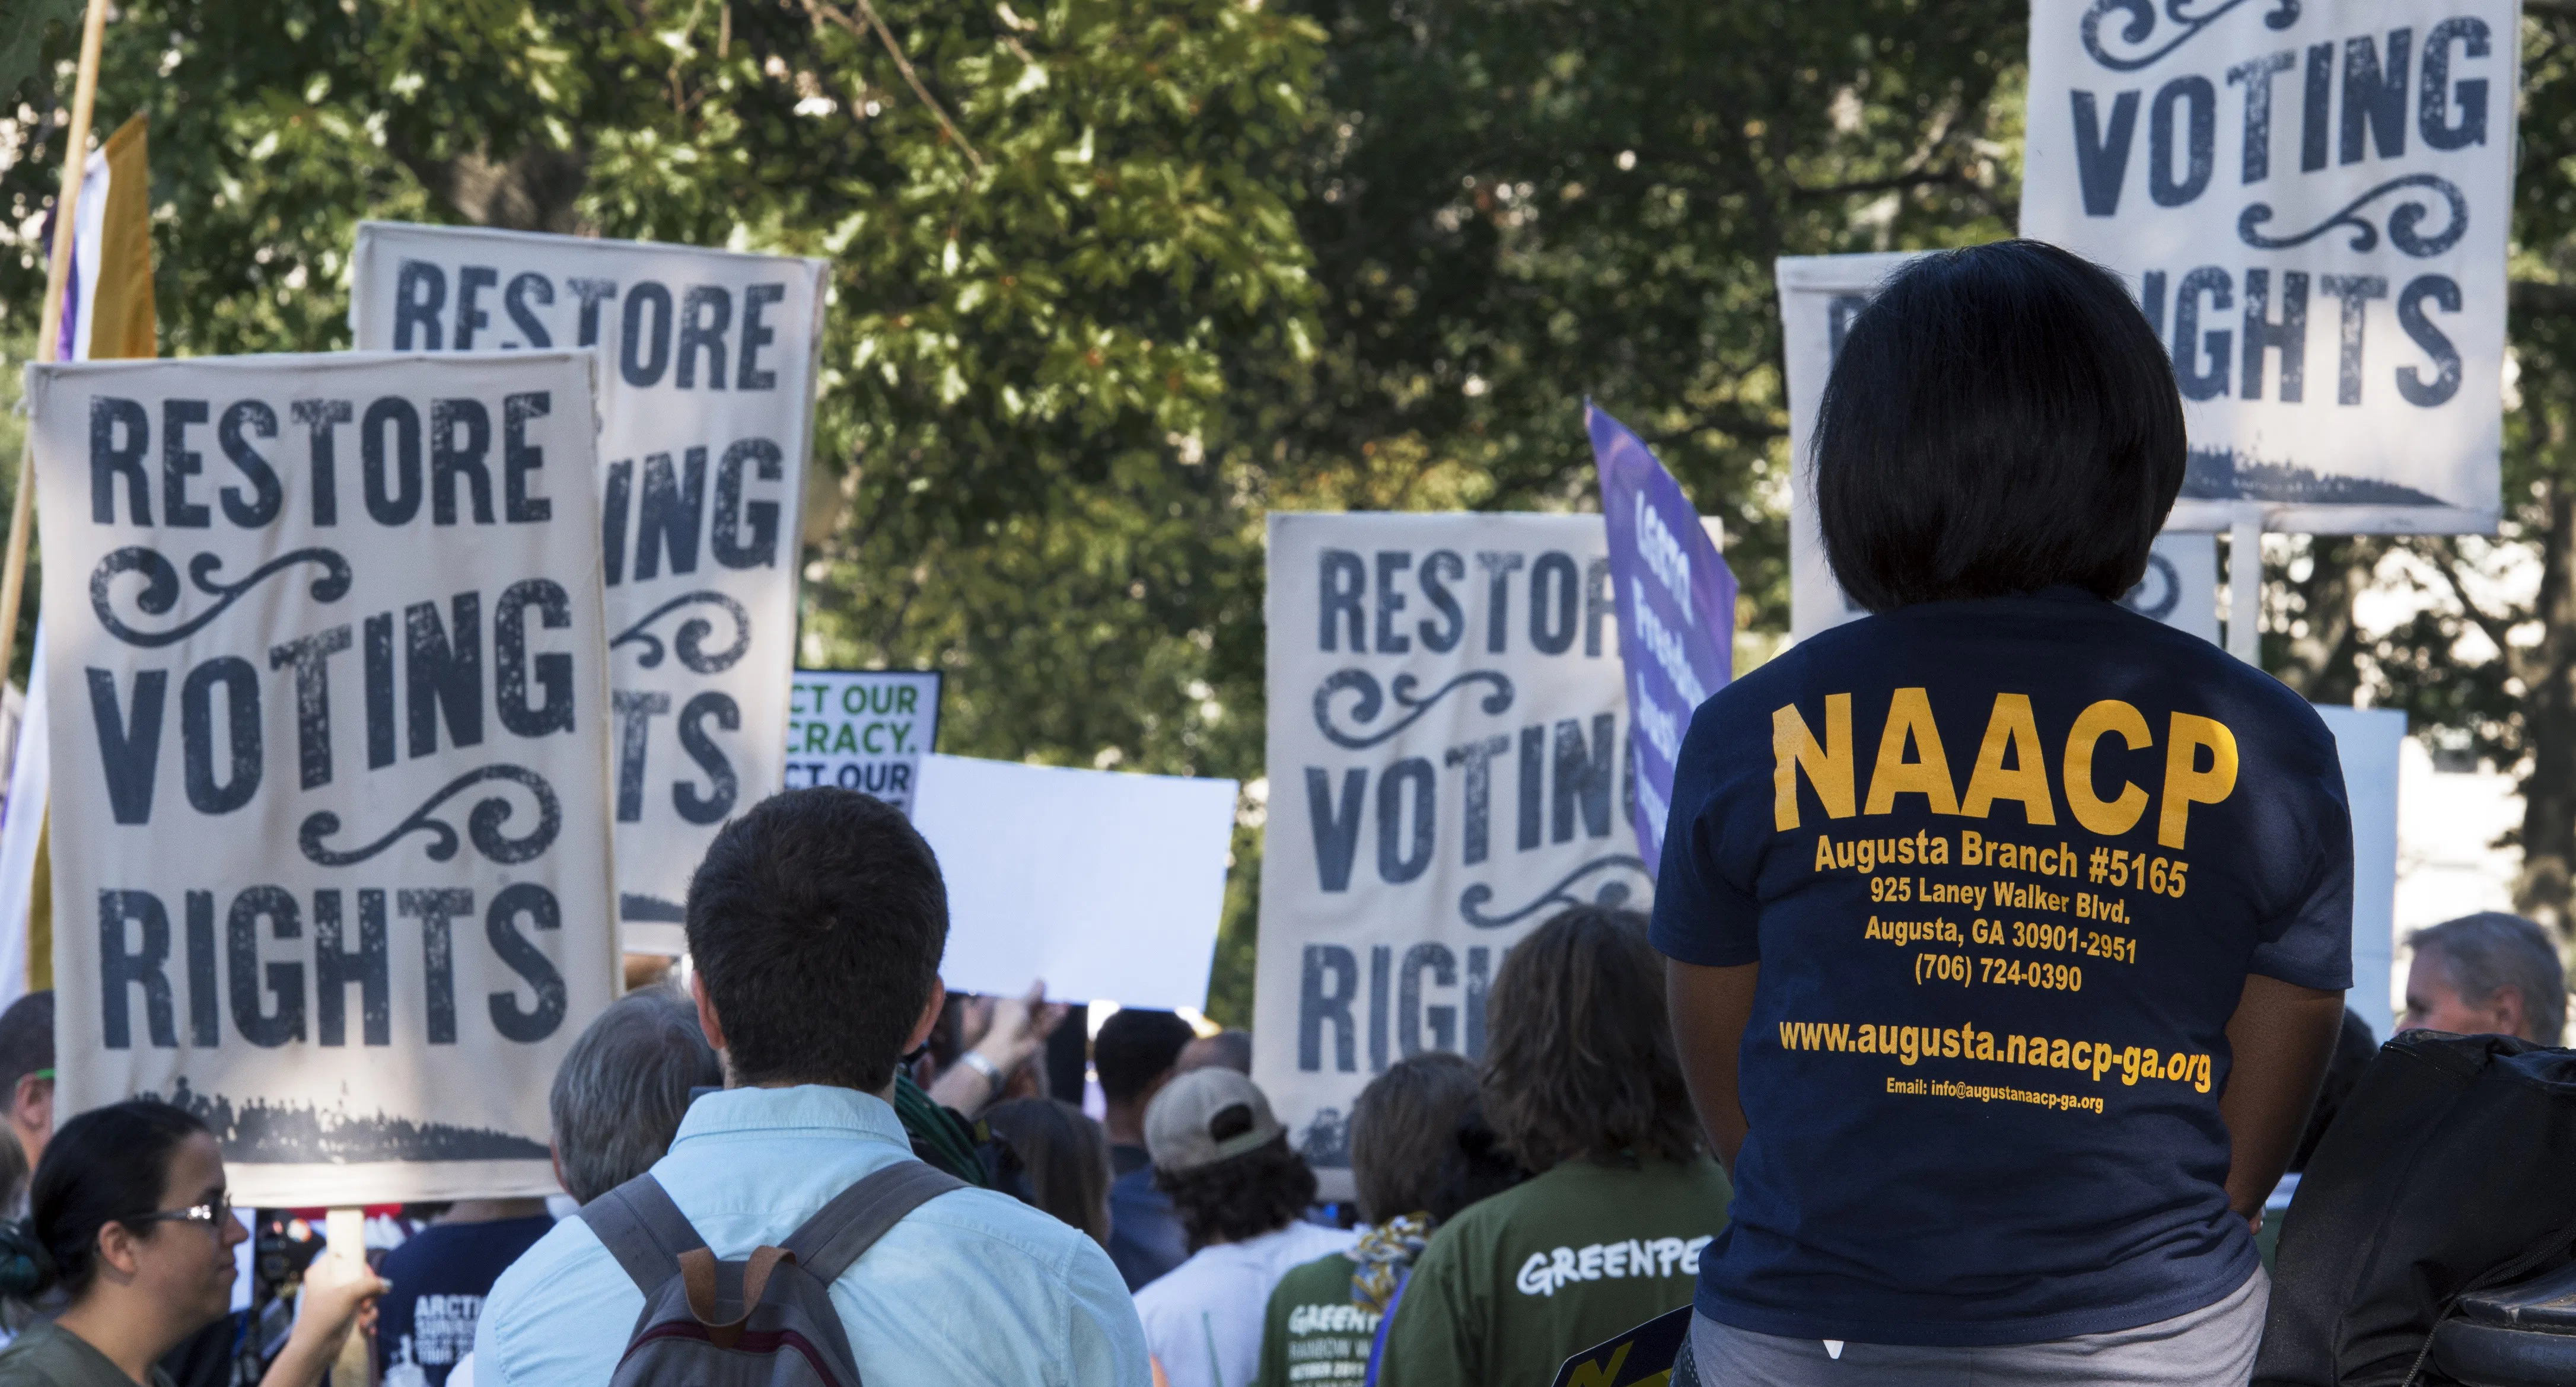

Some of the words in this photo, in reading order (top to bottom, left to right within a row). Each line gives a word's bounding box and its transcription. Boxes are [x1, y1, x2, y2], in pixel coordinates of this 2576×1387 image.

[2070, 16, 2492, 217] VOTING
[393, 259, 786, 391] RESTORE
[2142, 266, 2464, 408] IGHTS
[90, 391, 552, 528] RESTORE
[603, 436, 784, 587] ING
[1318, 547, 1623, 658] RESTOR
[86, 577, 575, 825] VOTING
[842, 685, 918, 715] OUR
[838, 763, 910, 792] OUR
[1772, 687, 2239, 850] NAACP
[1815, 829, 1948, 873] Augusta
[1961, 830, 2077, 878] Branch
[2089, 847, 2189, 898] #5165
[1871, 876, 1911, 902] 925
[1919, 877, 1987, 911] Laney
[1993, 881, 2069, 913] Walker
[2076, 892, 2130, 924] Blvd.
[98, 882, 568, 1049] RIGHTS
[1864, 916, 1964, 948] Augusta,
[1972, 919, 2005, 945] GA
[2012, 921, 2136, 964] 30901-2951
[1915, 953, 1972, 987] (706)
[1980, 958, 2082, 992] 724-0390
[1779, 1021, 2211, 1094] www.augusta.naacp-ga.org
[1886, 1077, 1927, 1095] Email:
[1931, 1080, 2104, 1114] info@augustanaacp-ga.org
[1516, 1235, 1714, 1296] GREENPE
[415, 1294, 486, 1320] ARCTI
